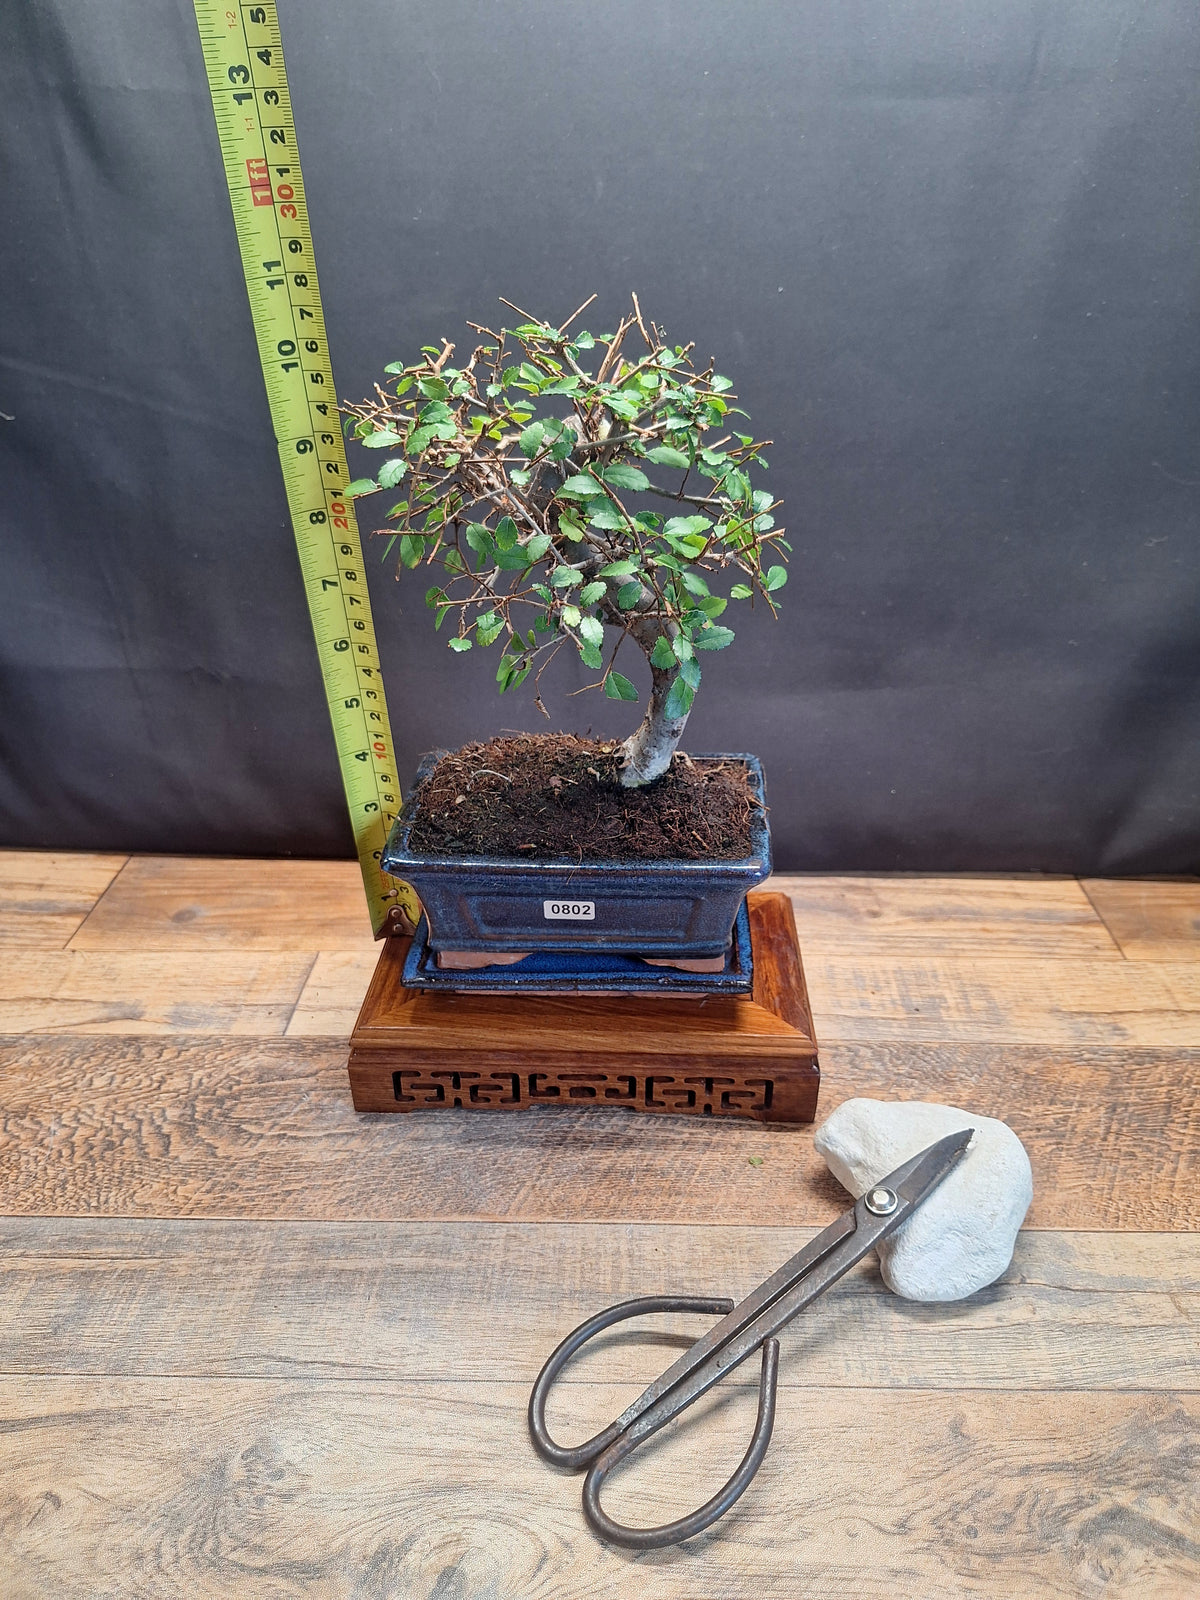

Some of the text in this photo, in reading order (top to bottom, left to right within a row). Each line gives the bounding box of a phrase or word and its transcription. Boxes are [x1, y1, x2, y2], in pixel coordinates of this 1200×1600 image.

[250, 7, 266, 24] 5
[257, 49, 272, 66] 4
[264, 90, 279, 105] 3
[270, 130, 285, 144] 2
[277, 184, 297, 218] 30
[288, 240, 302, 253] 9
[263, 260, 284, 290] 11
[294, 274, 308, 288] 8
[299, 308, 313, 320] 7
[306, 340, 318, 352] 6
[278, 340, 298, 373] 10
[311, 373, 324, 384] 5
[316, 404, 328, 416] 4
[321, 434, 334, 445] 3
[296, 440, 314, 454] 9
[326, 463, 339, 474] 2
[310, 511, 326, 524] 8
[331, 502, 348, 530] 20
[340, 545, 353, 556] 9
[345, 572, 357, 581] 8
[322, 579, 338, 591] 7
[350, 596, 361, 606] 7
[334, 640, 350, 652] 6
[358, 646, 369, 654] 5
[362, 668, 373, 677] 4
[366, 691, 377, 699] 3
[344, 698, 360, 708] 5
[370, 712, 381, 721] 2
[355, 752, 369, 762] 4
[374, 742, 387, 760] 10
[364, 802, 378, 812] 3
[552, 904, 591, 915] 0802
